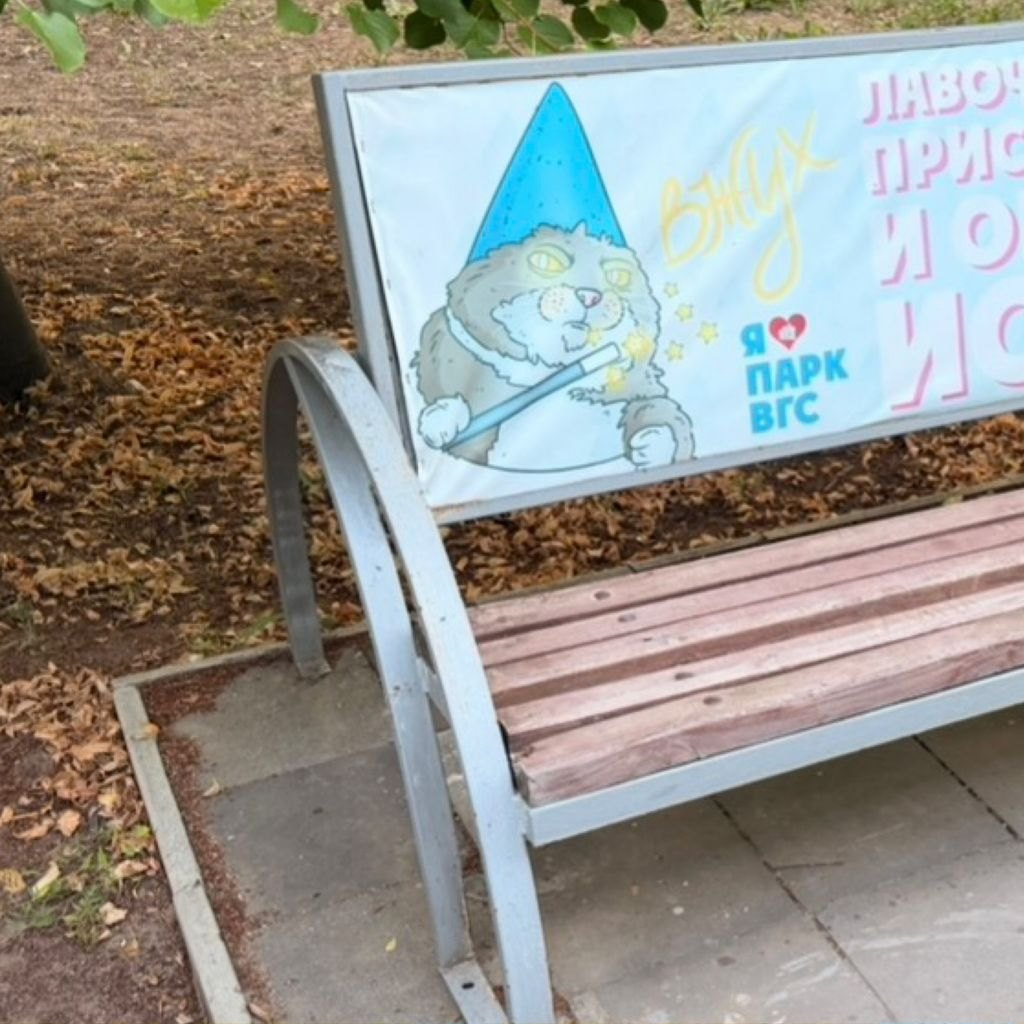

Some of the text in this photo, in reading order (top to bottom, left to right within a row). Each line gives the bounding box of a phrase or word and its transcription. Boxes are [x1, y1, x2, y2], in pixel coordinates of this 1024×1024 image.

[880, 207, 932, 286] И
[740, 322, 767, 358] Я
[746, 348, 849, 396] ПАРК
[750, 391, 820, 435] ВГС
